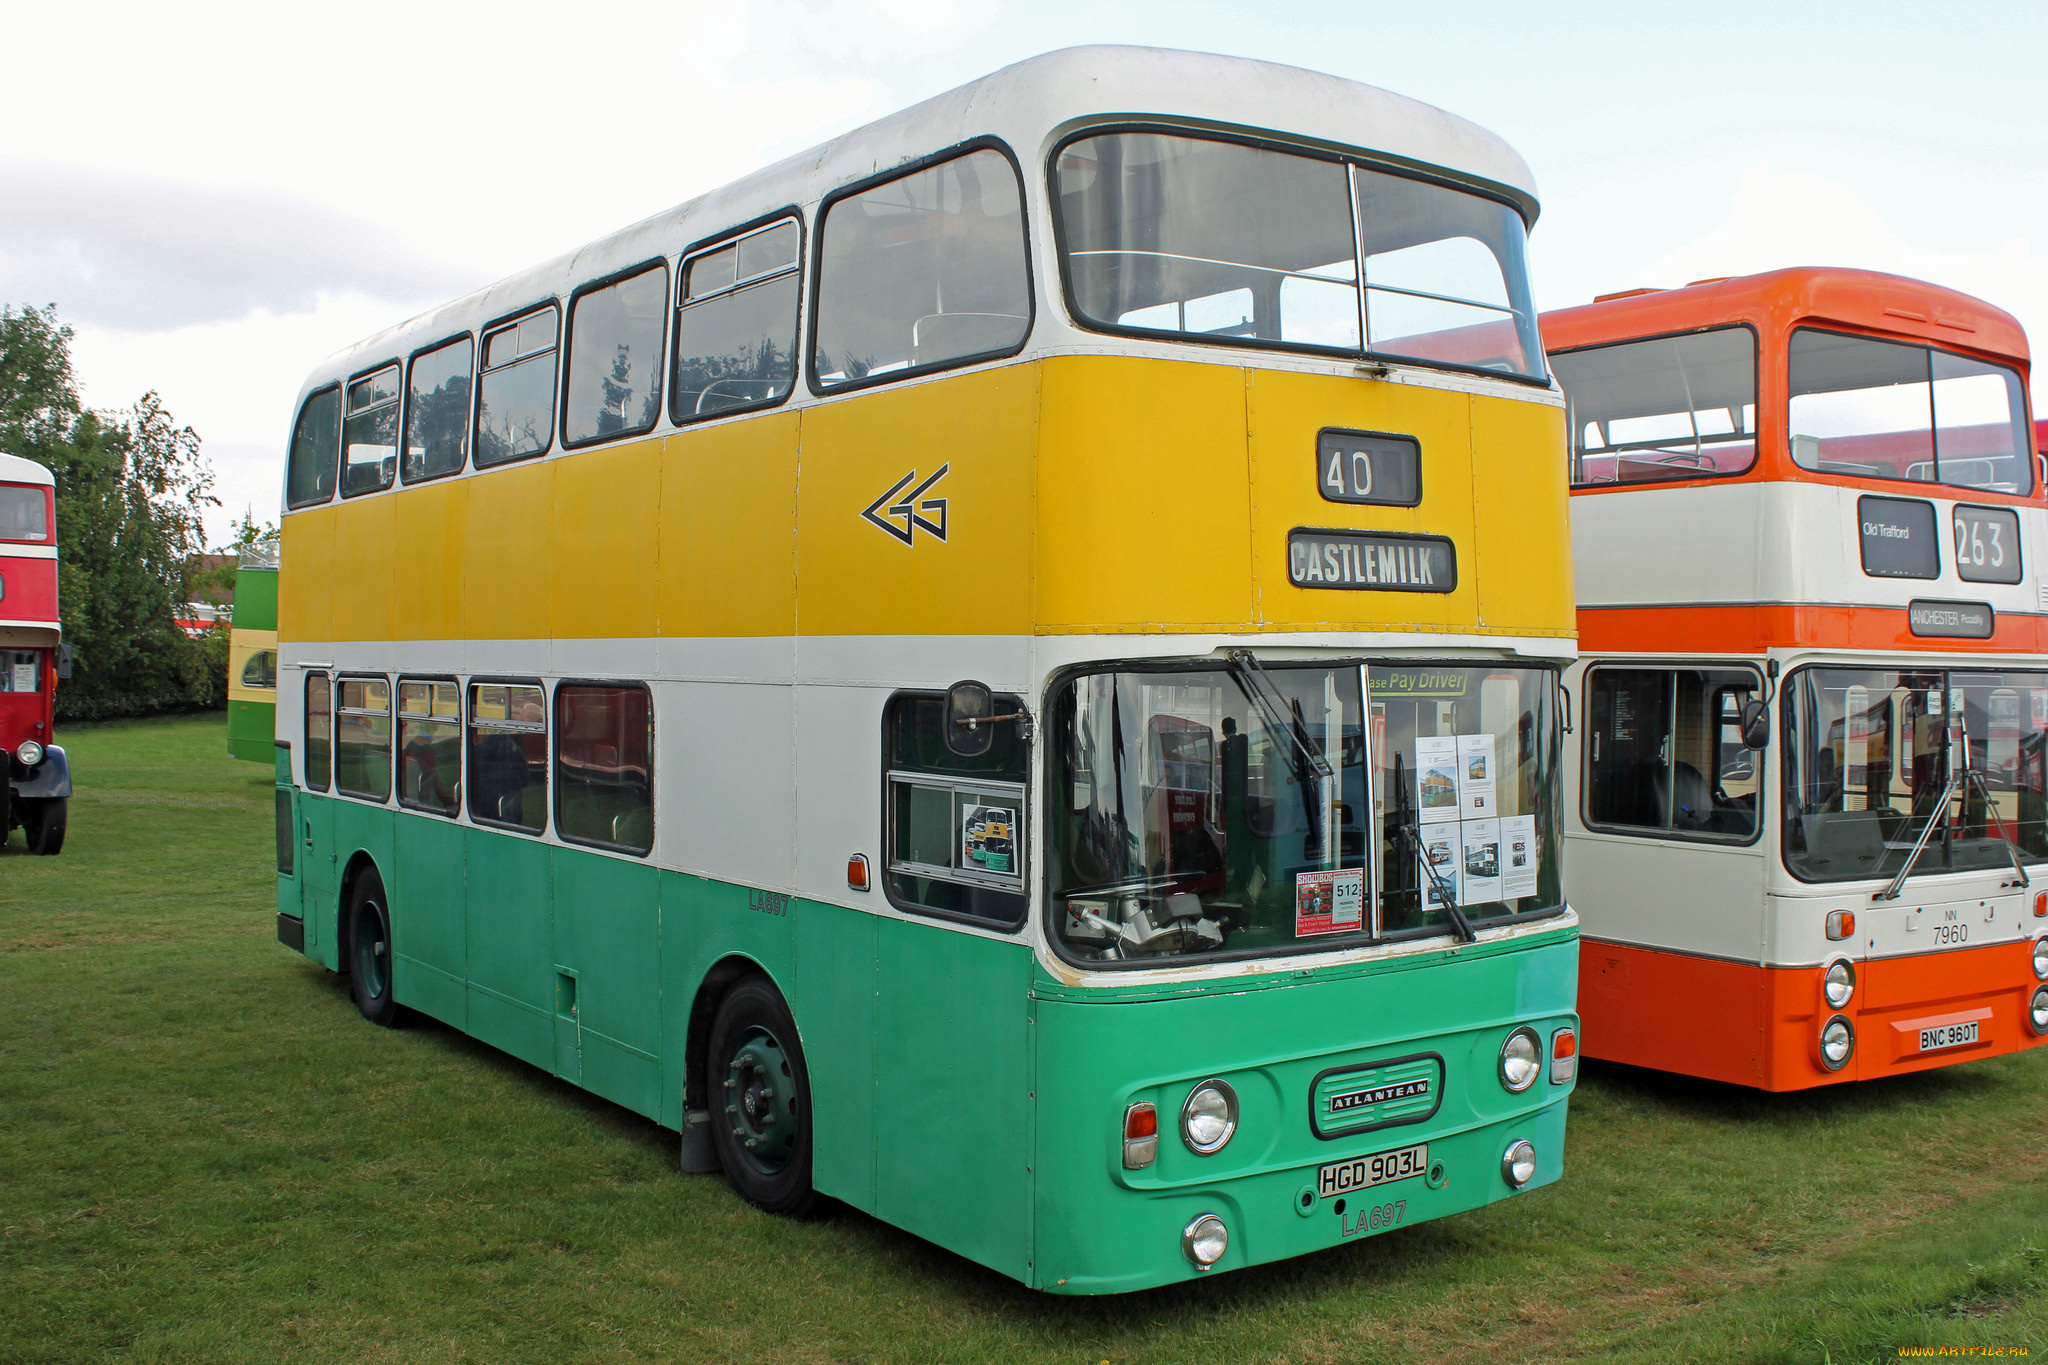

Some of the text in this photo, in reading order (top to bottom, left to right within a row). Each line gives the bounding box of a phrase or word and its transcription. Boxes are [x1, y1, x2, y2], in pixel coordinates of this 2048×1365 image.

[1326, 451, 1373, 496] 40
[1862, 522, 1910, 539] Old Trafford
[1955, 518, 2004, 567] 263
[1290, 541, 1434, 585] CASTLEMILK
[1389, 672, 1417, 691] Pay
[1418, 671, 1463, 689] Driver
[1298, 873, 1333, 884] SHOWBUS
[1337, 883, 1359, 897] 512
[748, 888, 789, 918] LA697
[1945, 910, 1957, 921] NN
[1934, 923, 1968, 945] 7960
[1921, 1023, 1978, 1049] BNC 960T
[1334, 1082, 1427, 1109] ATLANTEAN
[1322, 1149, 1425, 1194] HGD 903L
[1342, 1200, 1407, 1237] LA697
